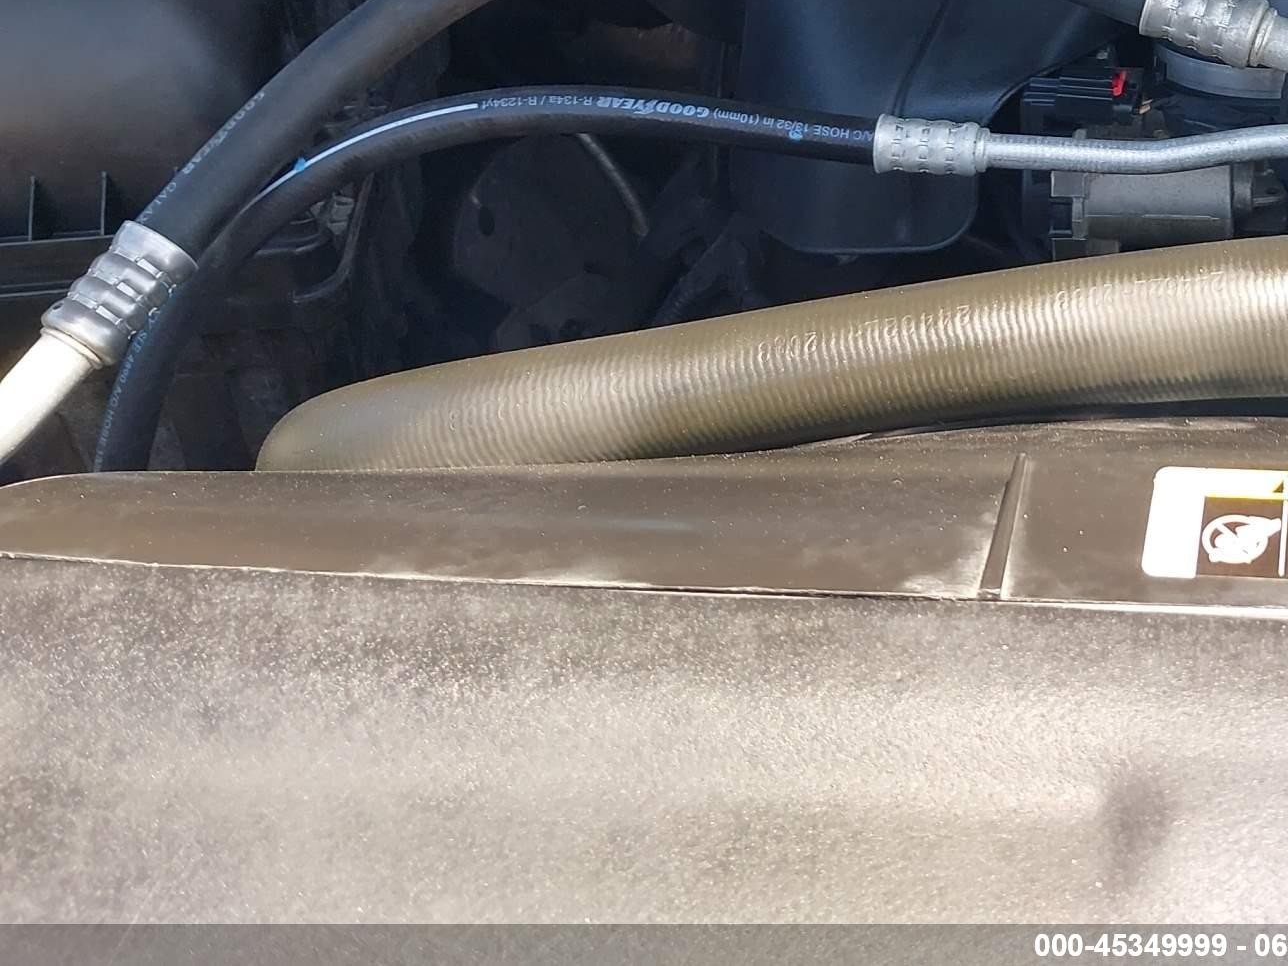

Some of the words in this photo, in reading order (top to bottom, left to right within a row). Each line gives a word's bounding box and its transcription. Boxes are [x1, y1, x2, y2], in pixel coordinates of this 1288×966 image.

[481, 95, 538, 111] R-1234yf
[548, 94, 594, 106] R-134a
[596, 95, 711, 119] GOODYEAR
[711, 107, 761, 126] (10mm)
[762, 116, 775, 129] in
[776, 118, 810, 135] 13/32
[813, 124, 850, 139] HOSE
